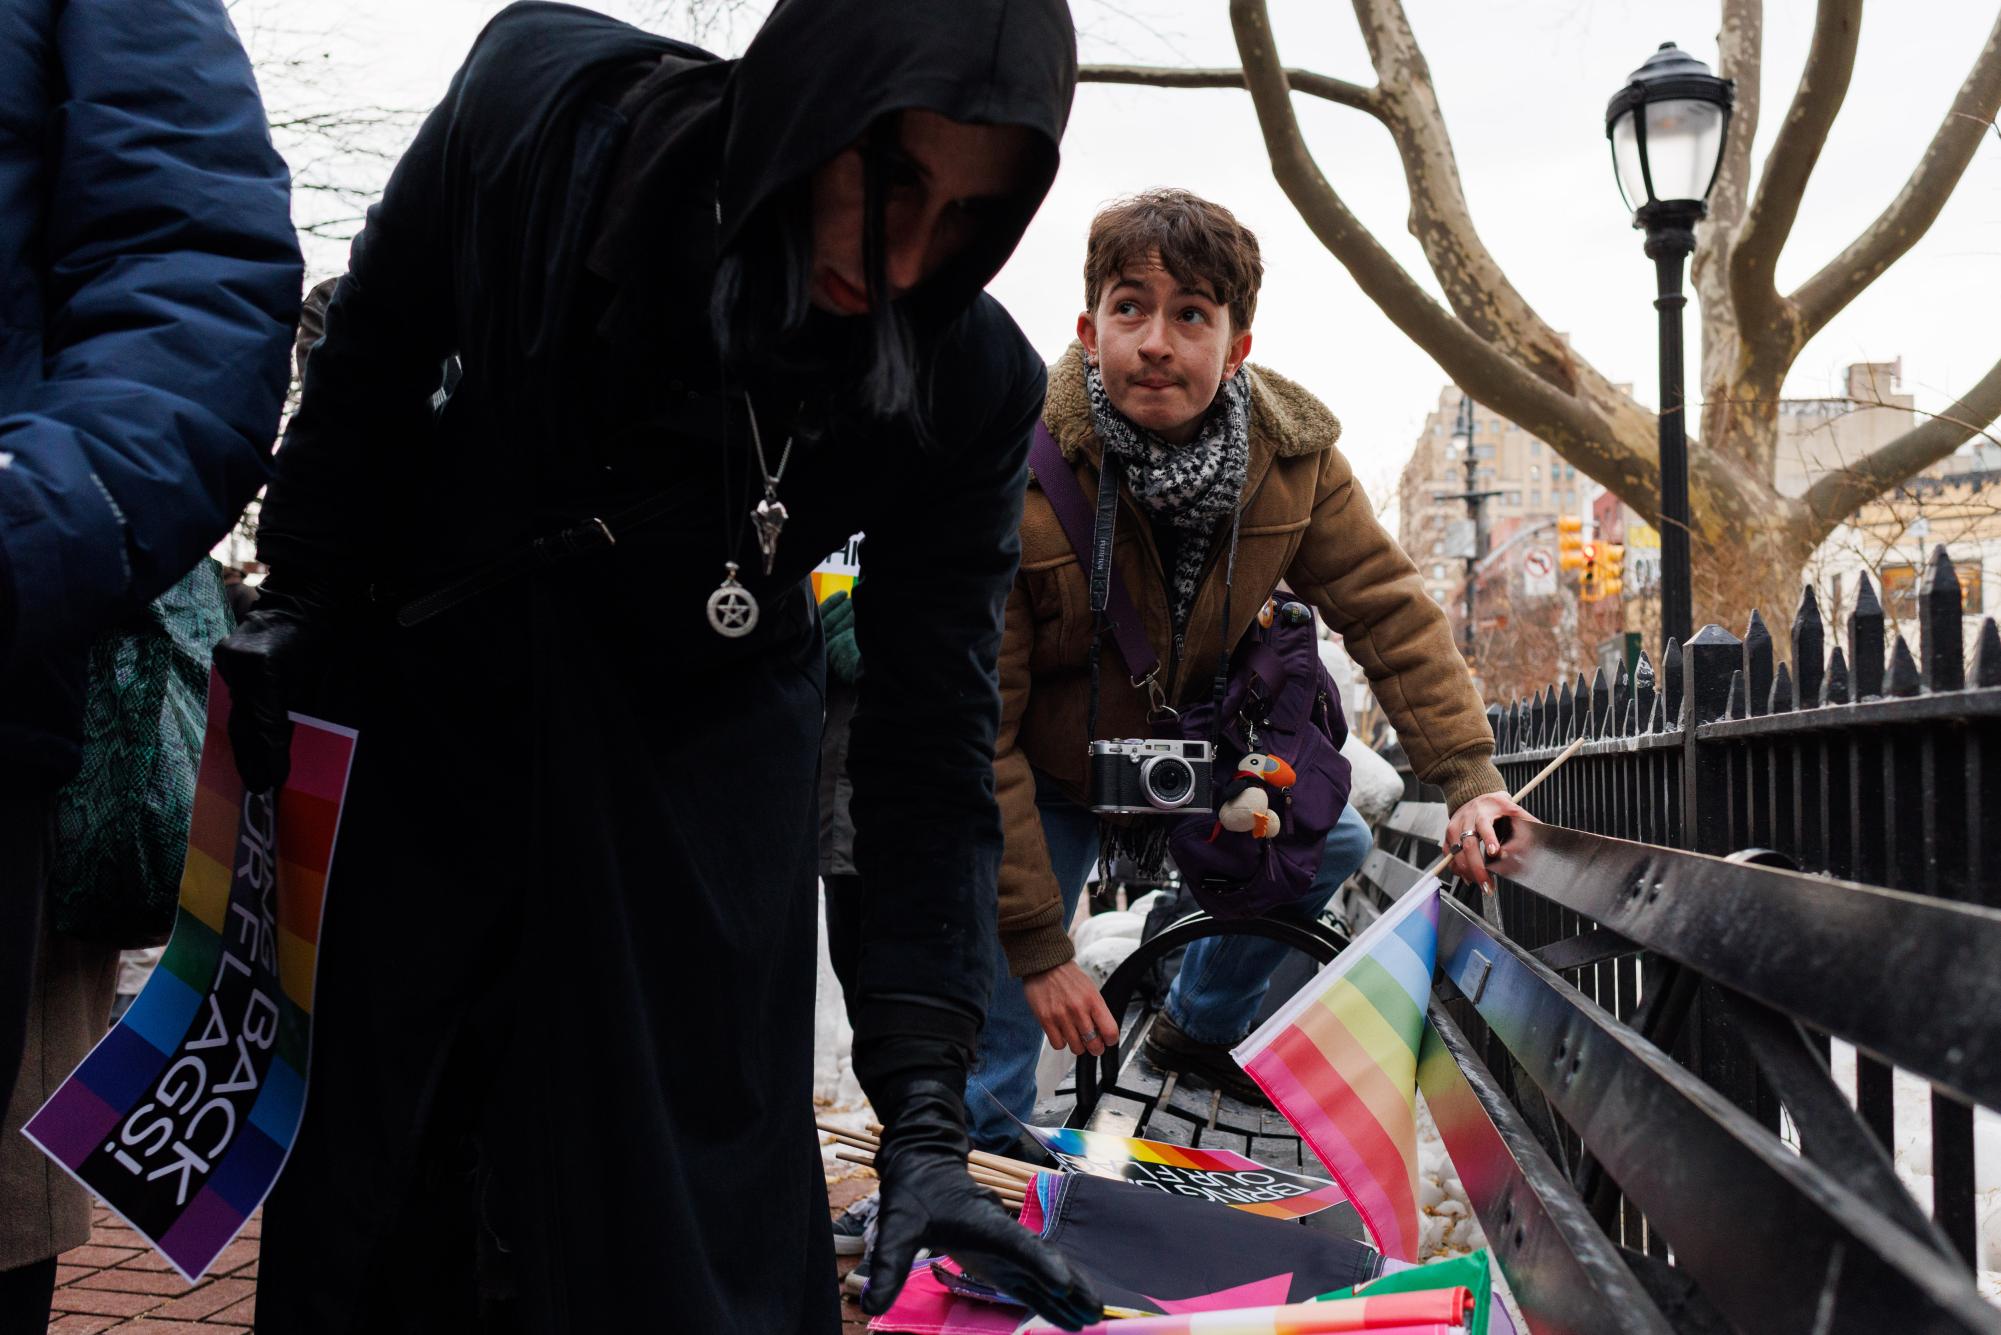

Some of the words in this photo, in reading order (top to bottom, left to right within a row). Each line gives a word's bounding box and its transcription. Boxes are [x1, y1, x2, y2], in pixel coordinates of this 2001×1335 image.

[103, 901, 259, 1176] FLAGS!
[147, 988, 280, 1205] BACK
[1175, 1182, 1311, 1204] BRING
[1179, 1168, 1275, 1188] OUR
